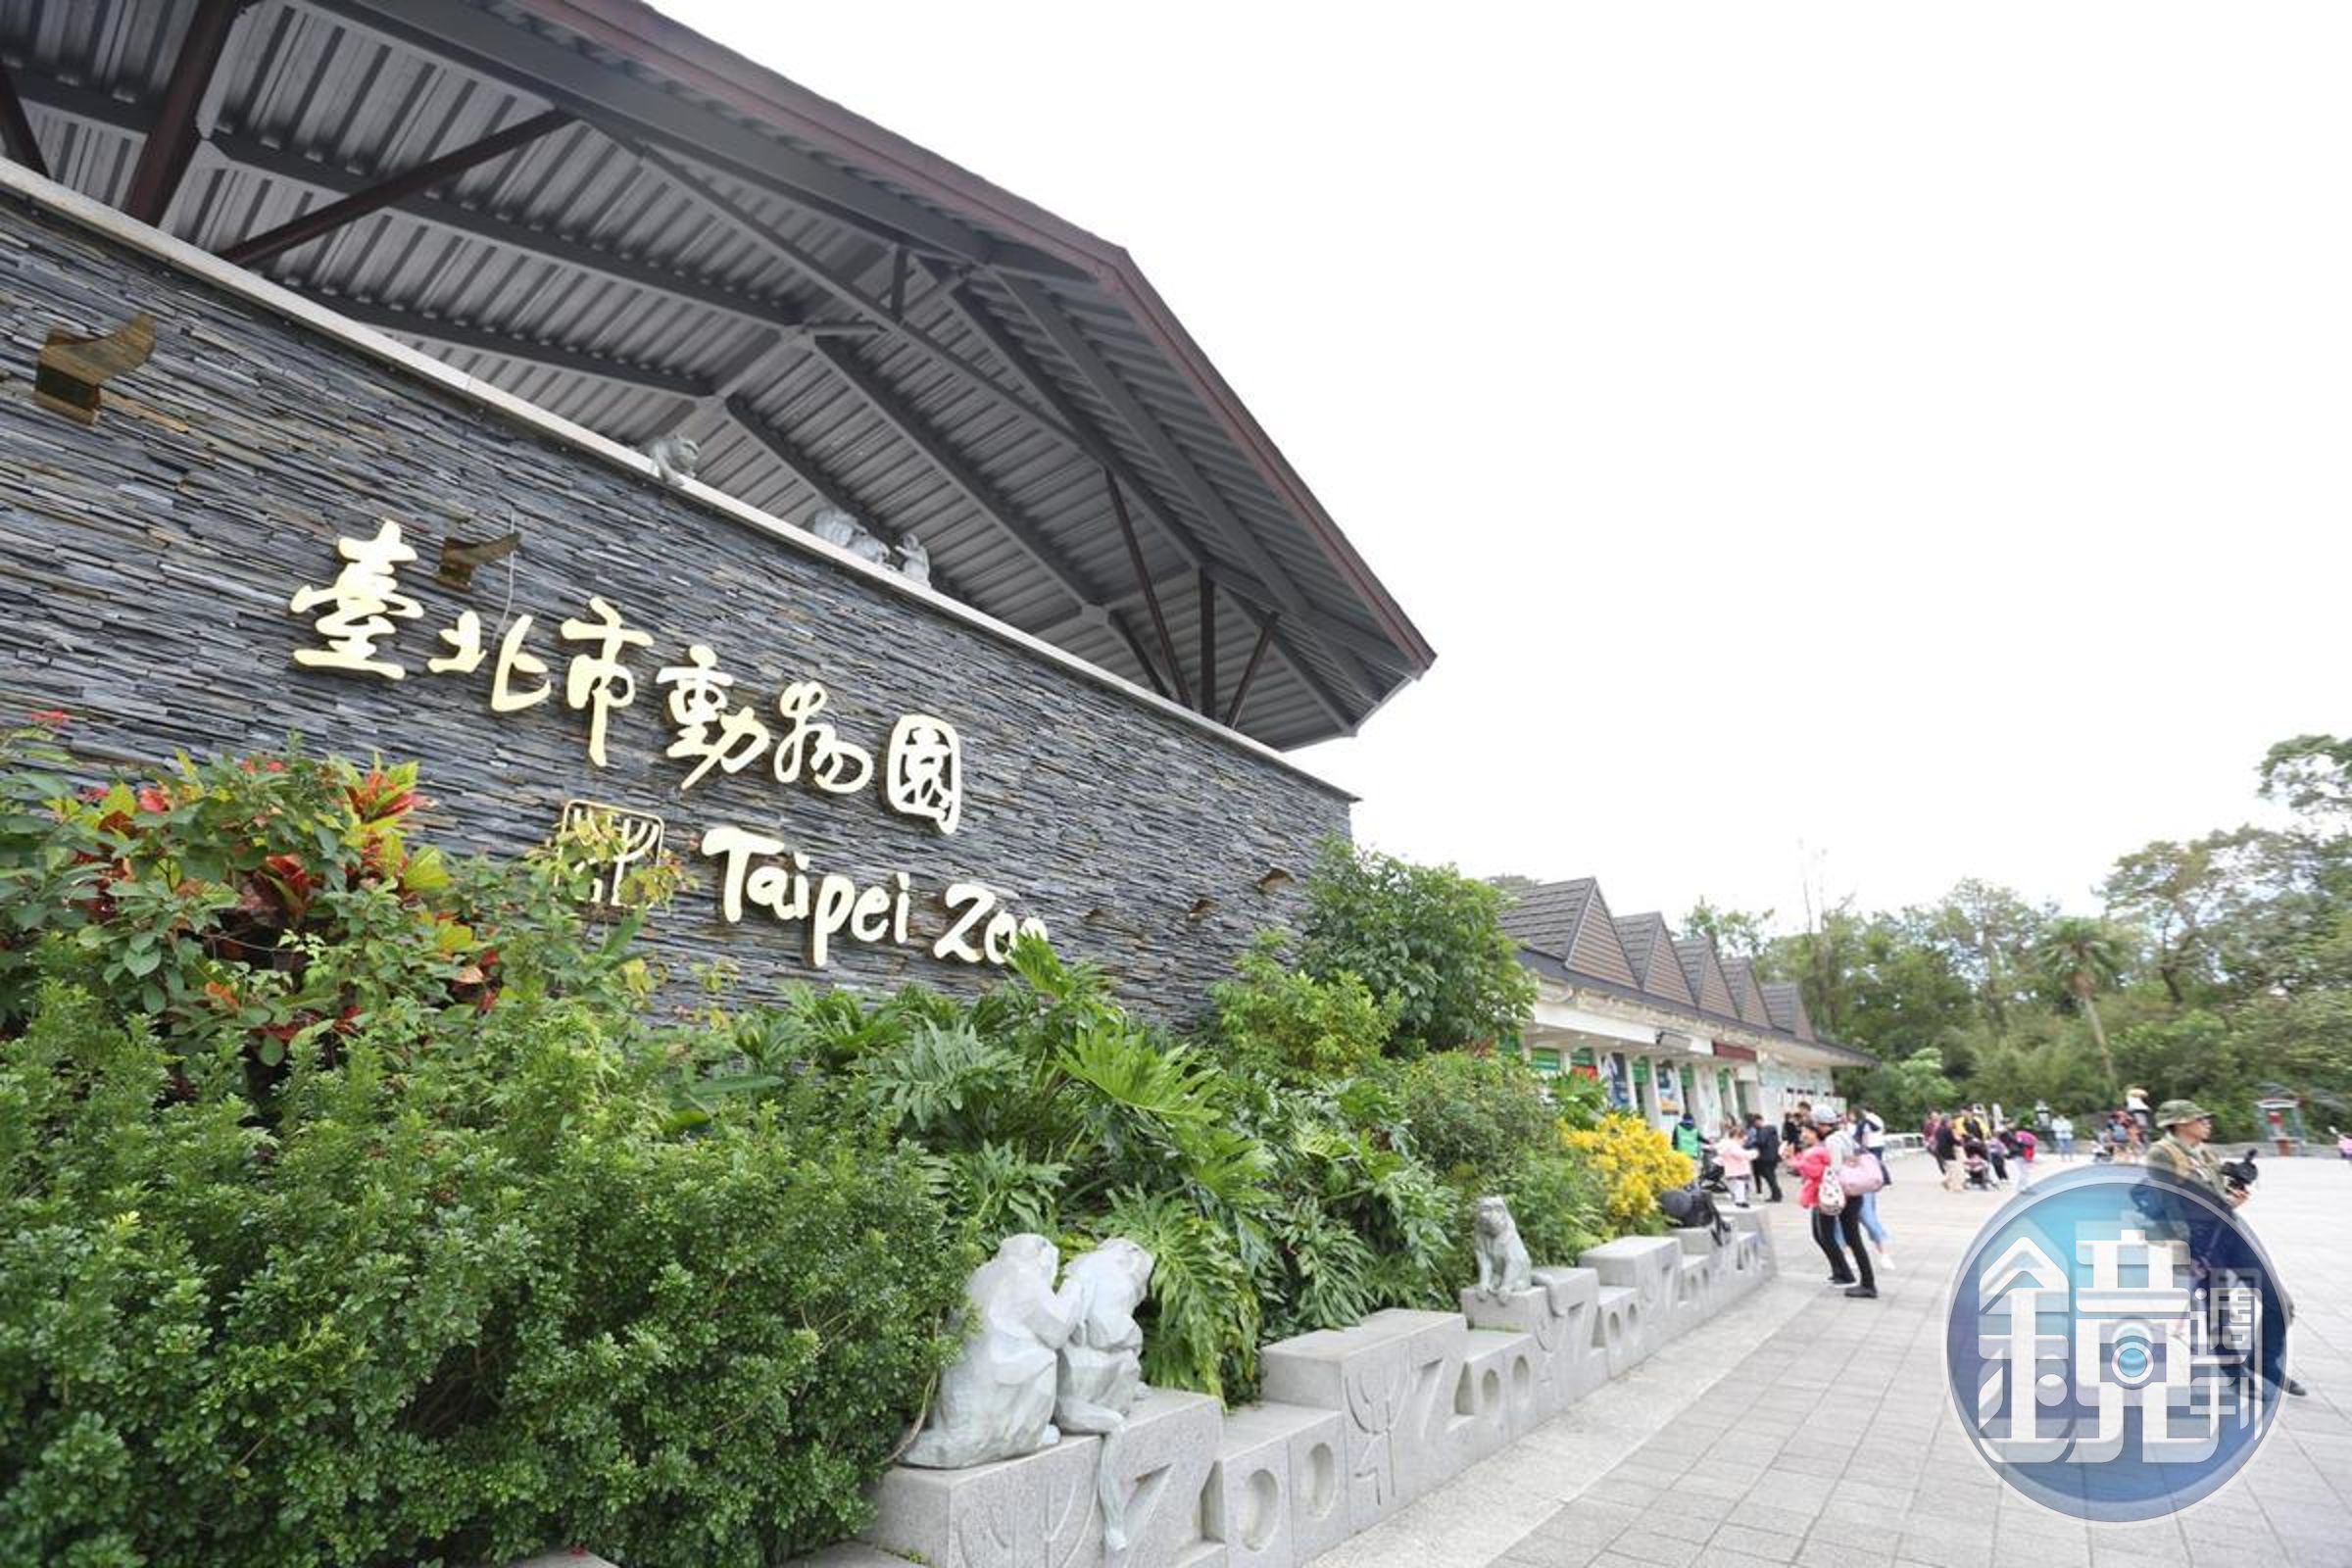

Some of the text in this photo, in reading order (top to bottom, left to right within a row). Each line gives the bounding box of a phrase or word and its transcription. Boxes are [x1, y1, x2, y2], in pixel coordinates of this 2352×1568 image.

[290, 518, 962, 835] 臺北市動物園
[701, 827, 910, 967] Taipei
